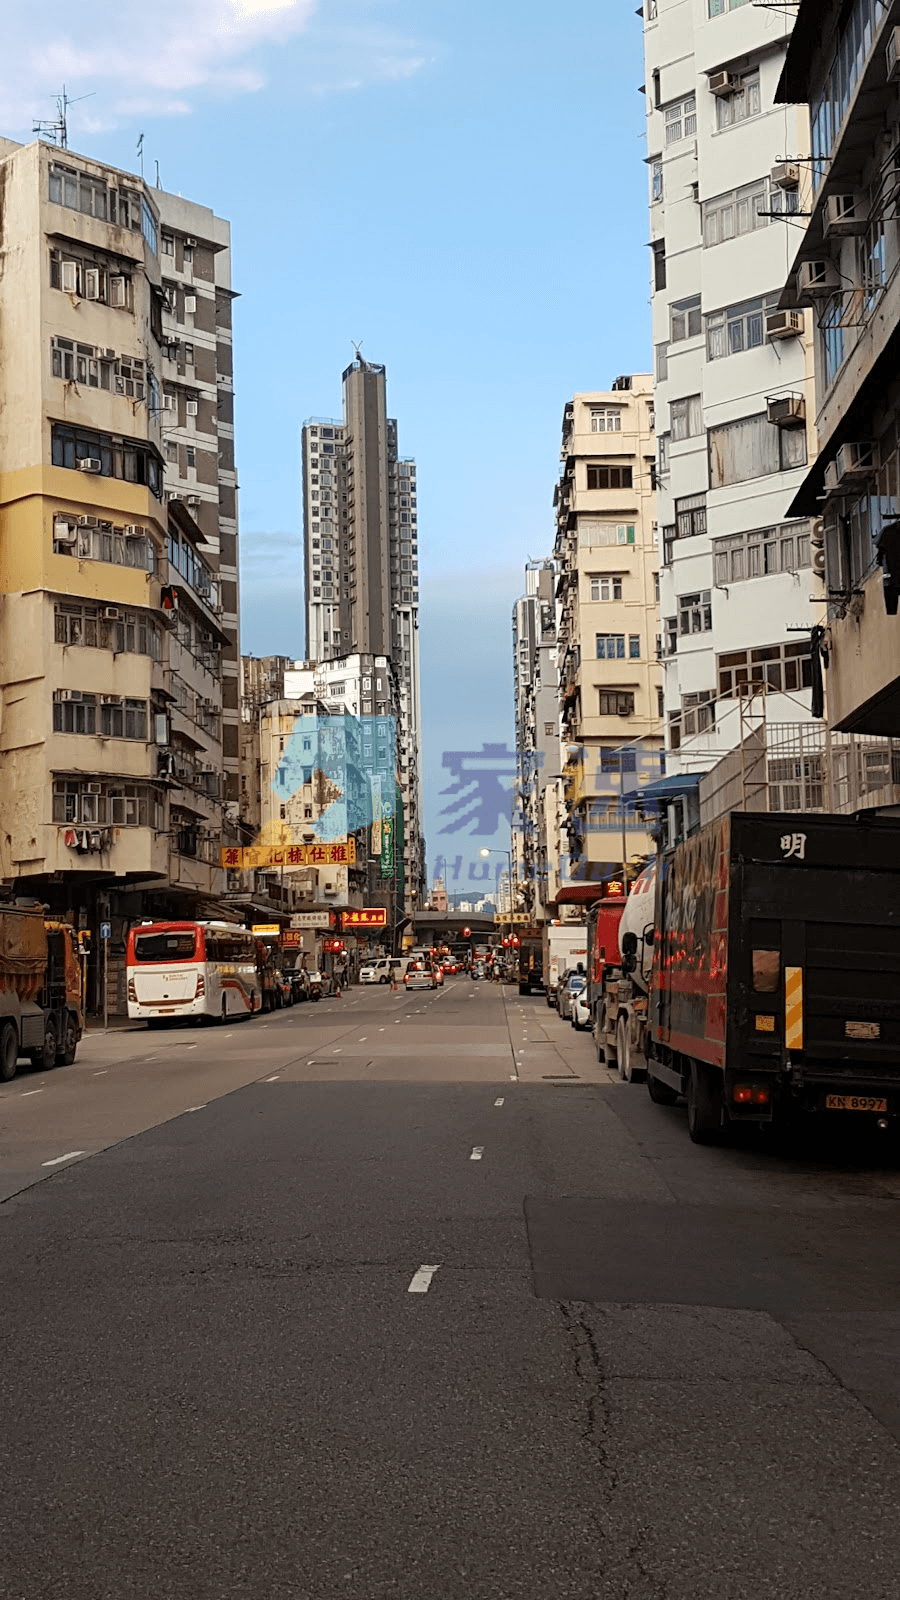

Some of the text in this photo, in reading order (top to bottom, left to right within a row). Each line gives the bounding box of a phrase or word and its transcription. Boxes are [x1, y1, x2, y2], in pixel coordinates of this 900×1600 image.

[780, 833, 807, 859] 明
[828, 1096, 884, 1110] KN 8997
